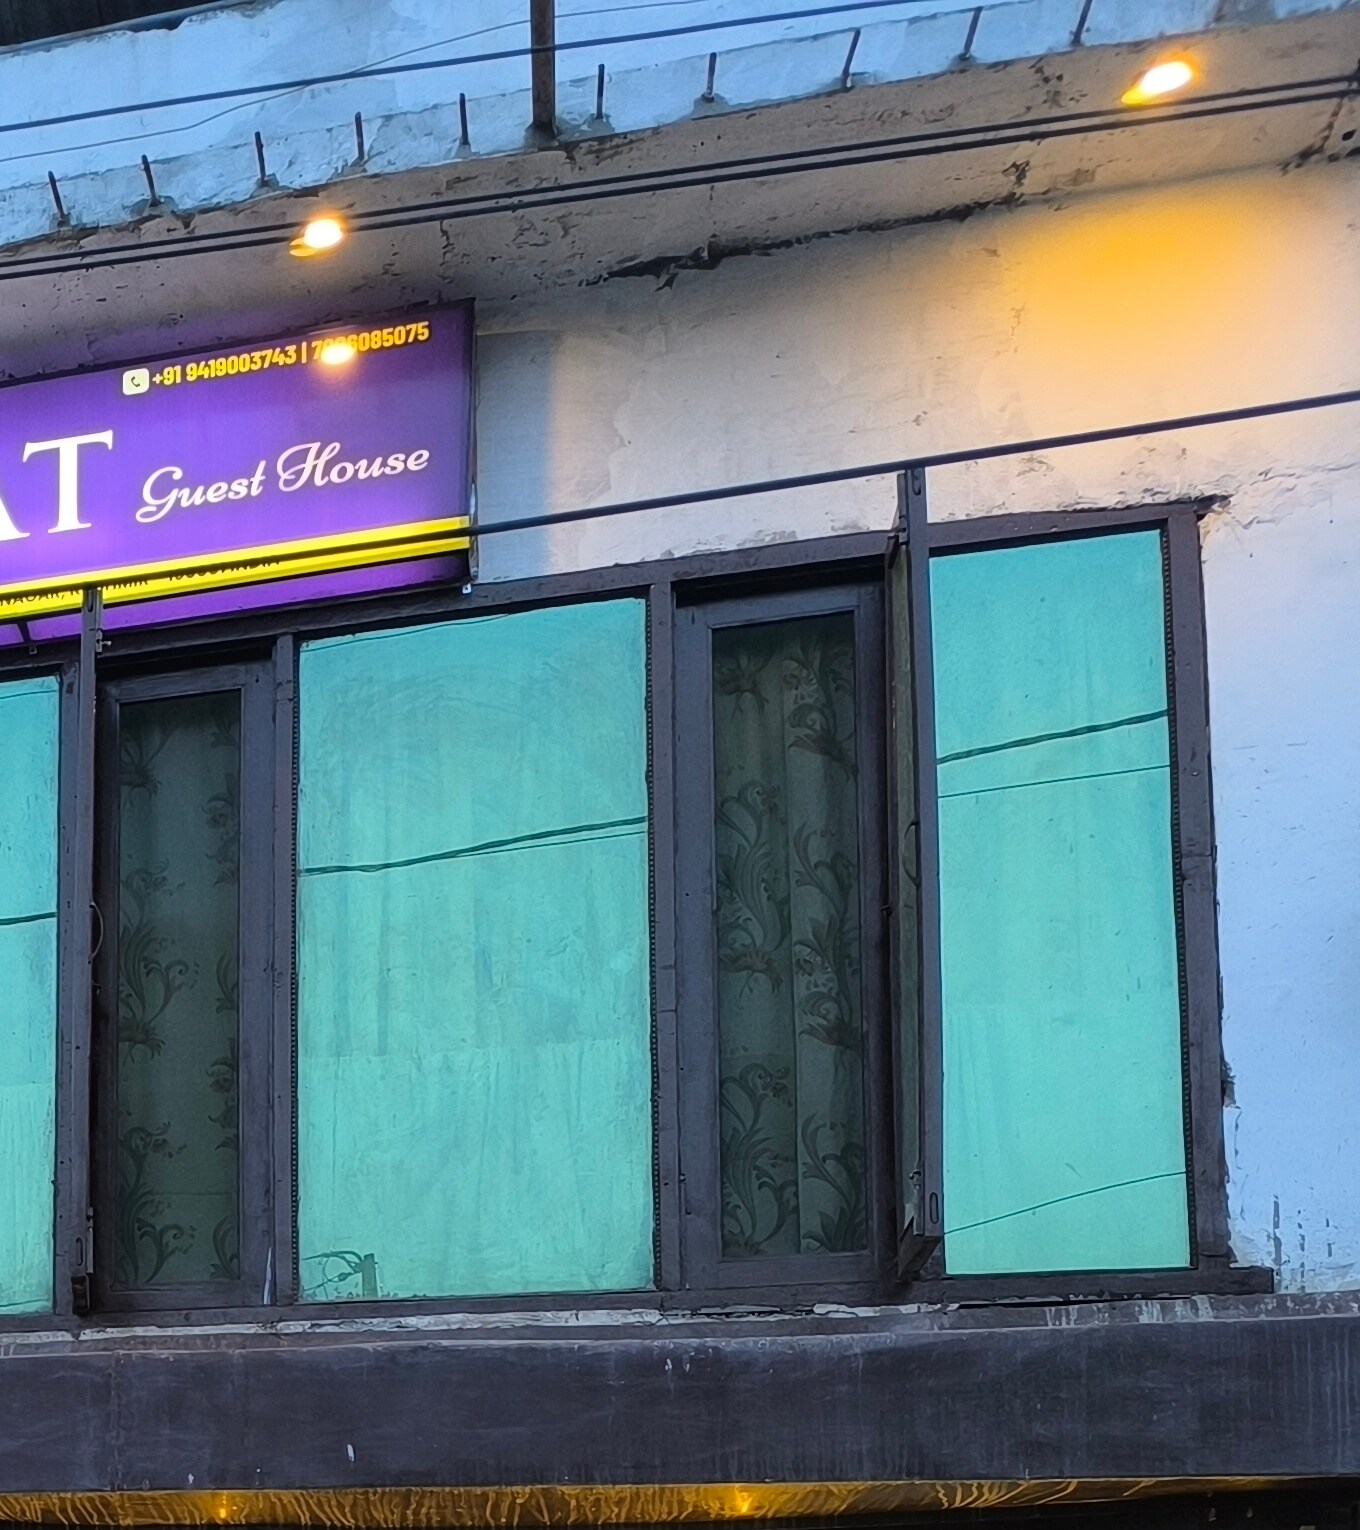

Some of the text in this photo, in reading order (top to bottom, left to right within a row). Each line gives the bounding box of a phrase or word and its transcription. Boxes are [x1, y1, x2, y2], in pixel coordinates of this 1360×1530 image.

[153, 365, 182, 386] +91
[186, 345, 297, 382] 9419003743
[135, 441, 430, 523] Guest House
